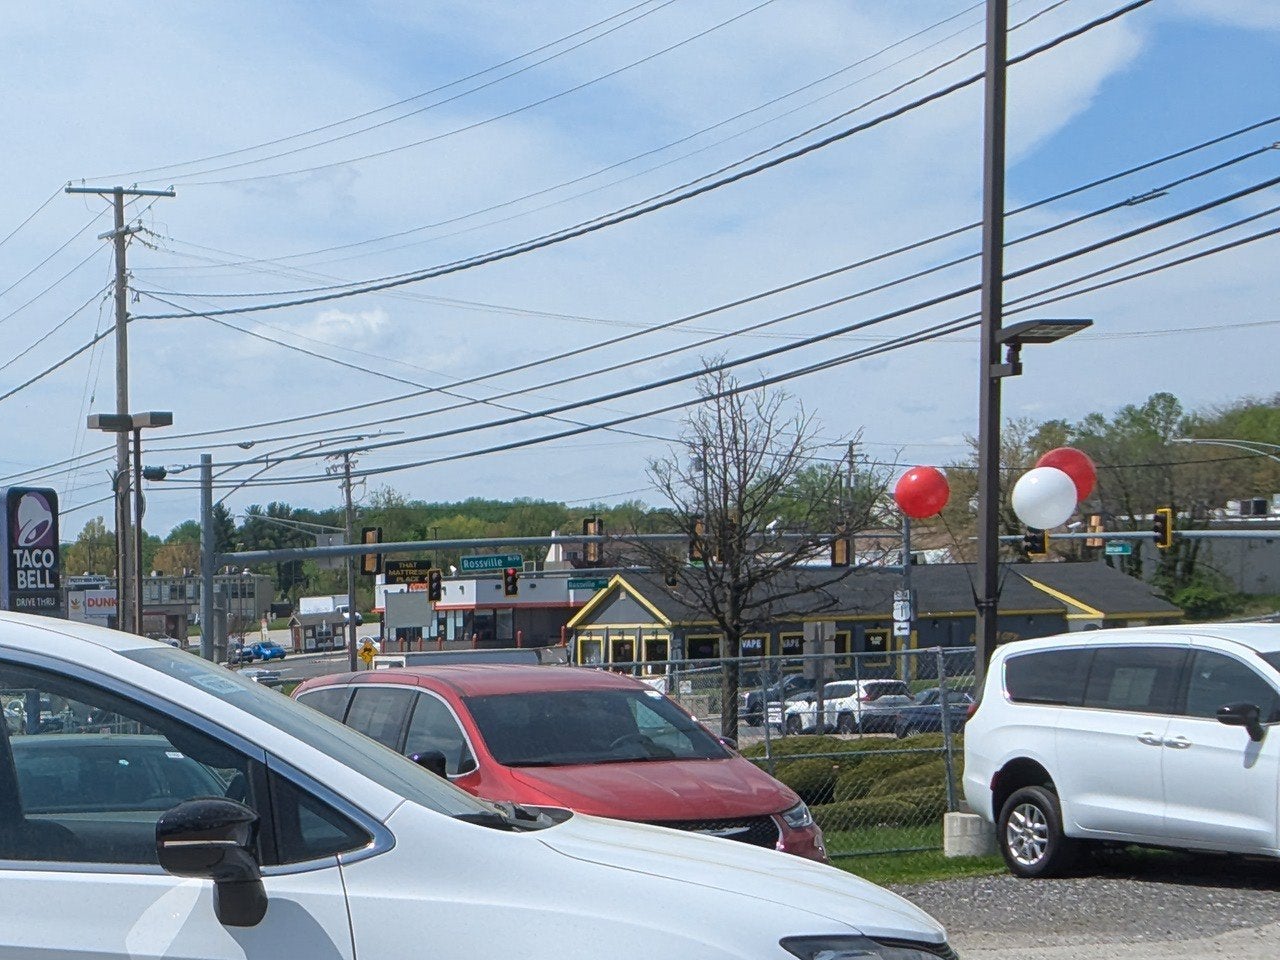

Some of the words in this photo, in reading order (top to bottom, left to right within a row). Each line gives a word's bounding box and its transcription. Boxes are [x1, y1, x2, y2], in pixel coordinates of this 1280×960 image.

[13, 549, 54, 568] TACO
[463, 557, 503, 568] Rossville
[17, 570, 54, 588] BELL
[16, 597, 35, 607] DRIVE
[36, 597, 56, 607] THRU
[742, 639, 761, 648] VAPE
